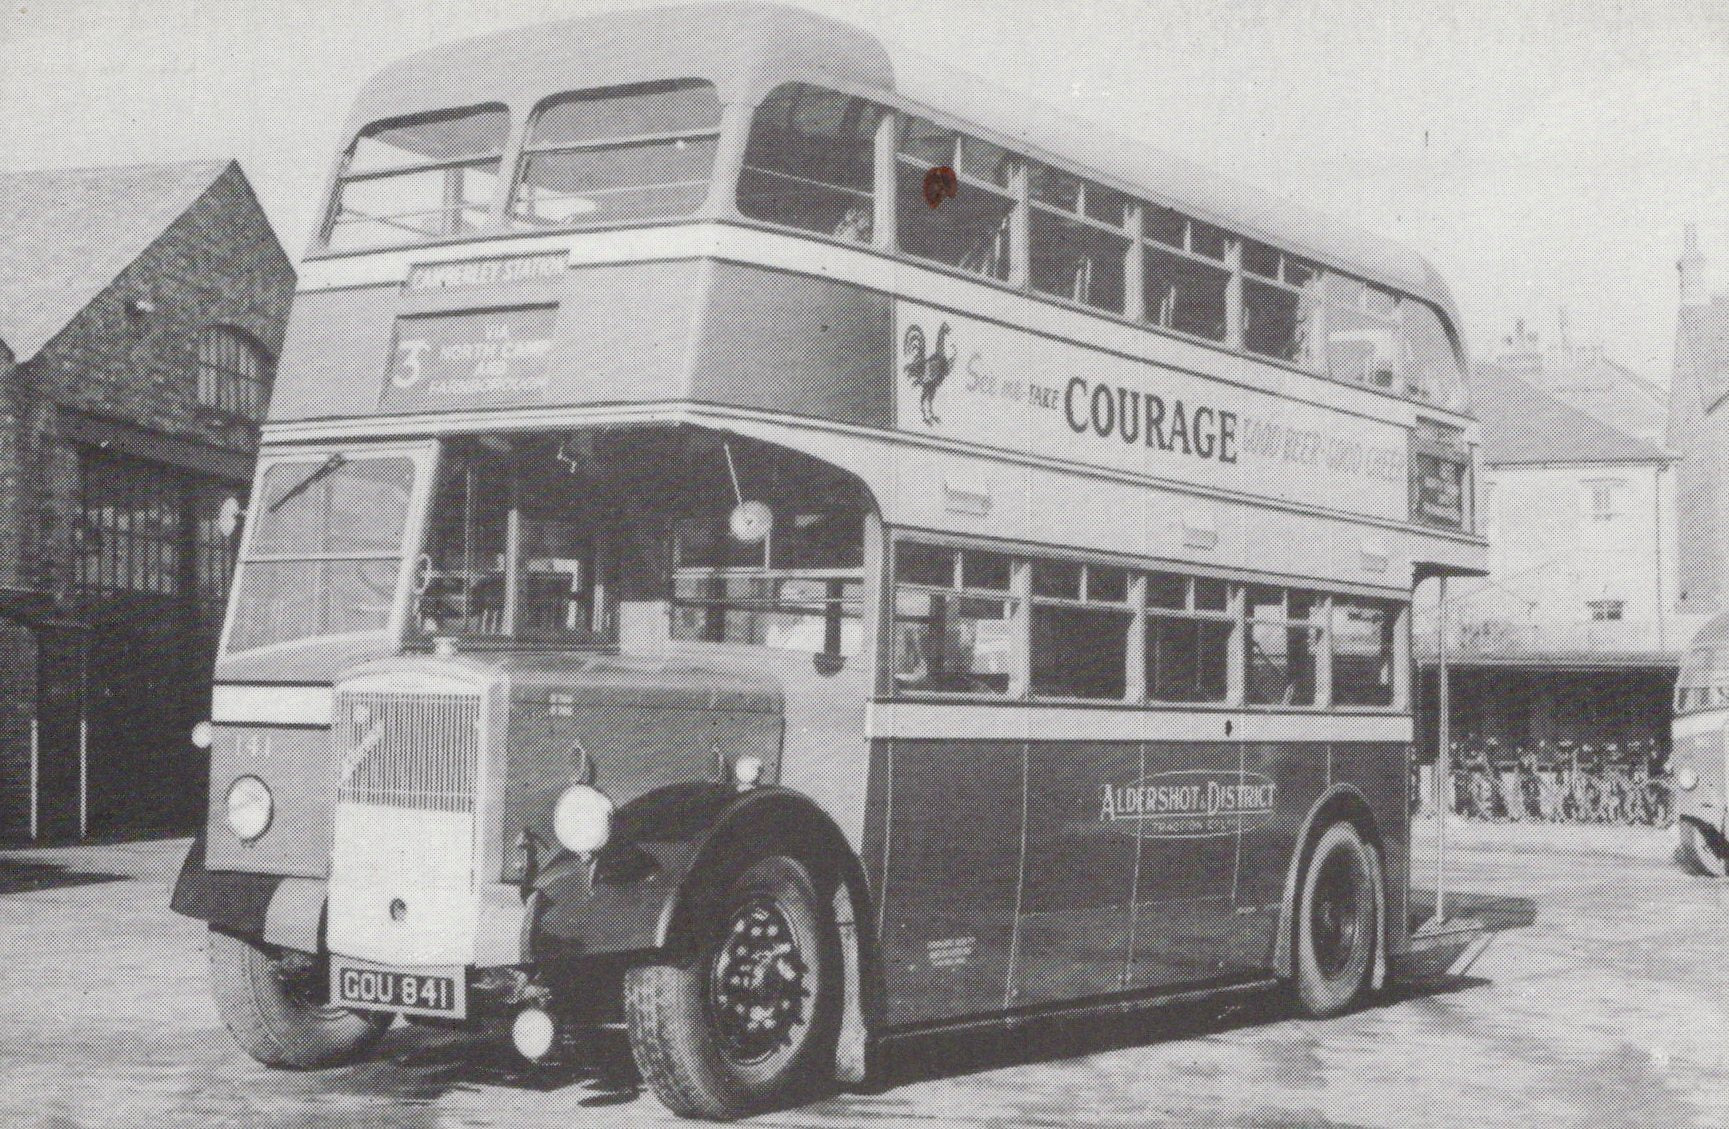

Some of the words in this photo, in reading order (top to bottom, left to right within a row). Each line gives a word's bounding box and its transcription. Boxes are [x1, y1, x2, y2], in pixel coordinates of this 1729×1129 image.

[501, 256, 564, 281] STATION
[484, 323, 508, 341] VIA
[392, 339, 431, 388] 3
[438, 342, 497, 361] NORTH
[1028, 384, 1059, 410] TAKE
[1064, 376, 1237, 464] COURAGE
[235, 734, 271, 758] 141
[343, 971, 393, 1003] GOU
[401, 976, 447, 1009] 841
